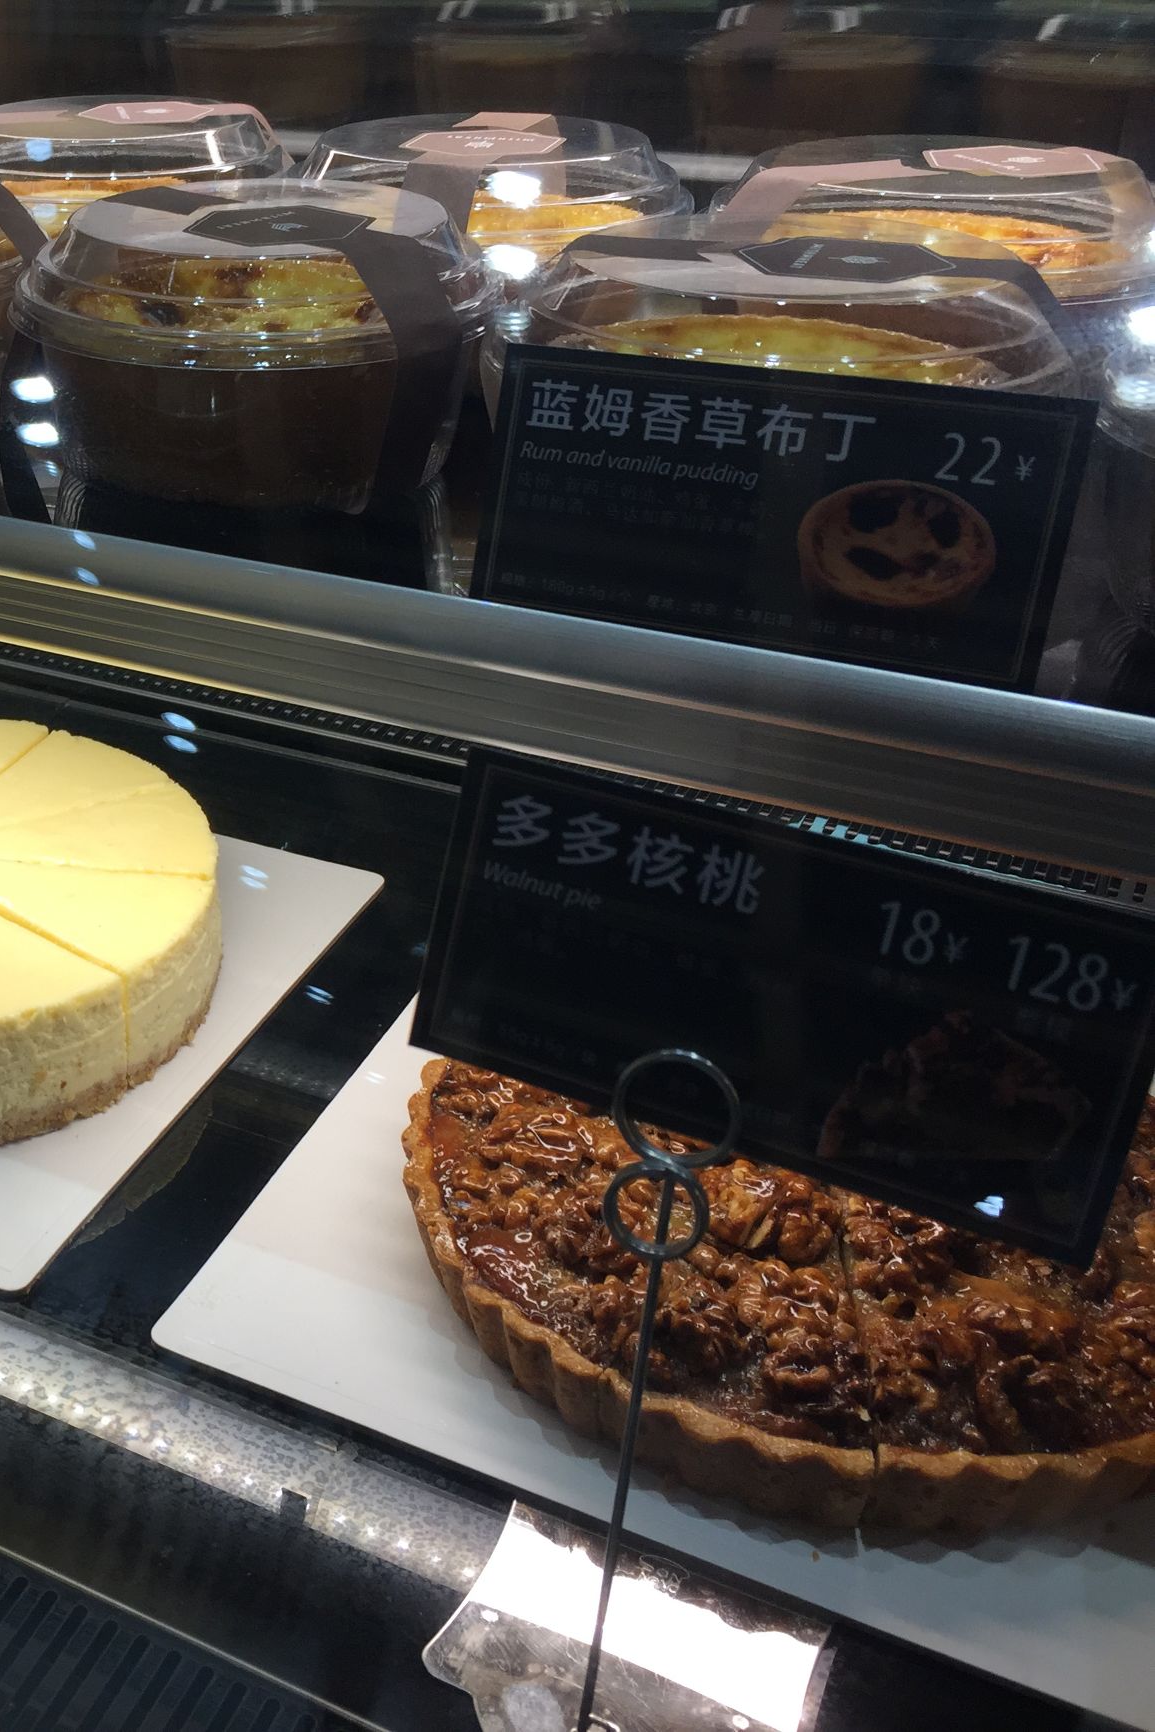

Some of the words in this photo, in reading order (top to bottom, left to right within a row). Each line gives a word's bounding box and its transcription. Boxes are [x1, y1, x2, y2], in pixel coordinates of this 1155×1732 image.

[525, 378, 877, 463] 蓝姆香草布丁
[520, 440, 563, 462] Rum
[566, 449, 606, 468] and
[608, 454, 673, 476] vanilla
[673, 461, 759, 491] pudding
[483, 859, 564, 901] Walnut
[561, 884, 602, 911] pie
[492, 794, 766, 915] 多多核桃
